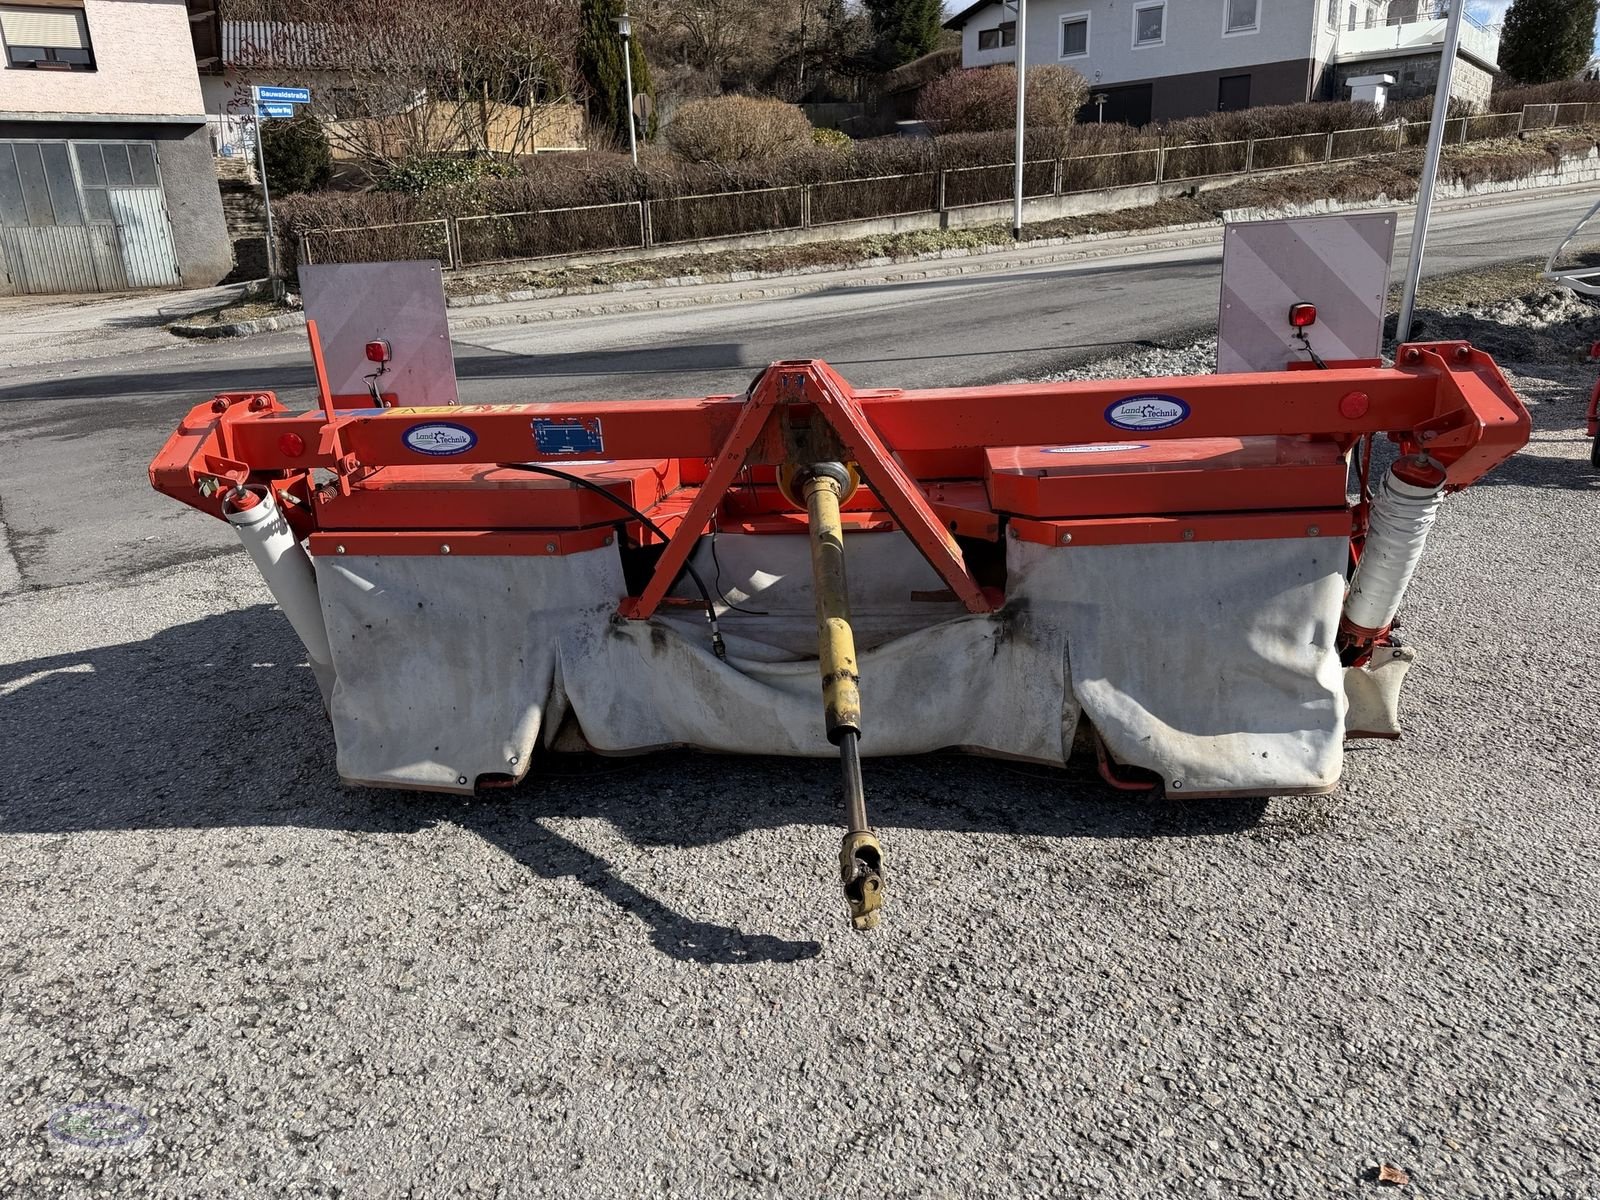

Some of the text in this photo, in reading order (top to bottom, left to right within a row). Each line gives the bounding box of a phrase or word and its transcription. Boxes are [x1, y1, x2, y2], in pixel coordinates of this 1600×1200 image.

[261, 90, 307, 99] Sauwaldstraße
[1121, 406, 1141, 414] Land
[1147, 409, 1177, 417] Technik
[416, 432, 433, 440] Land
